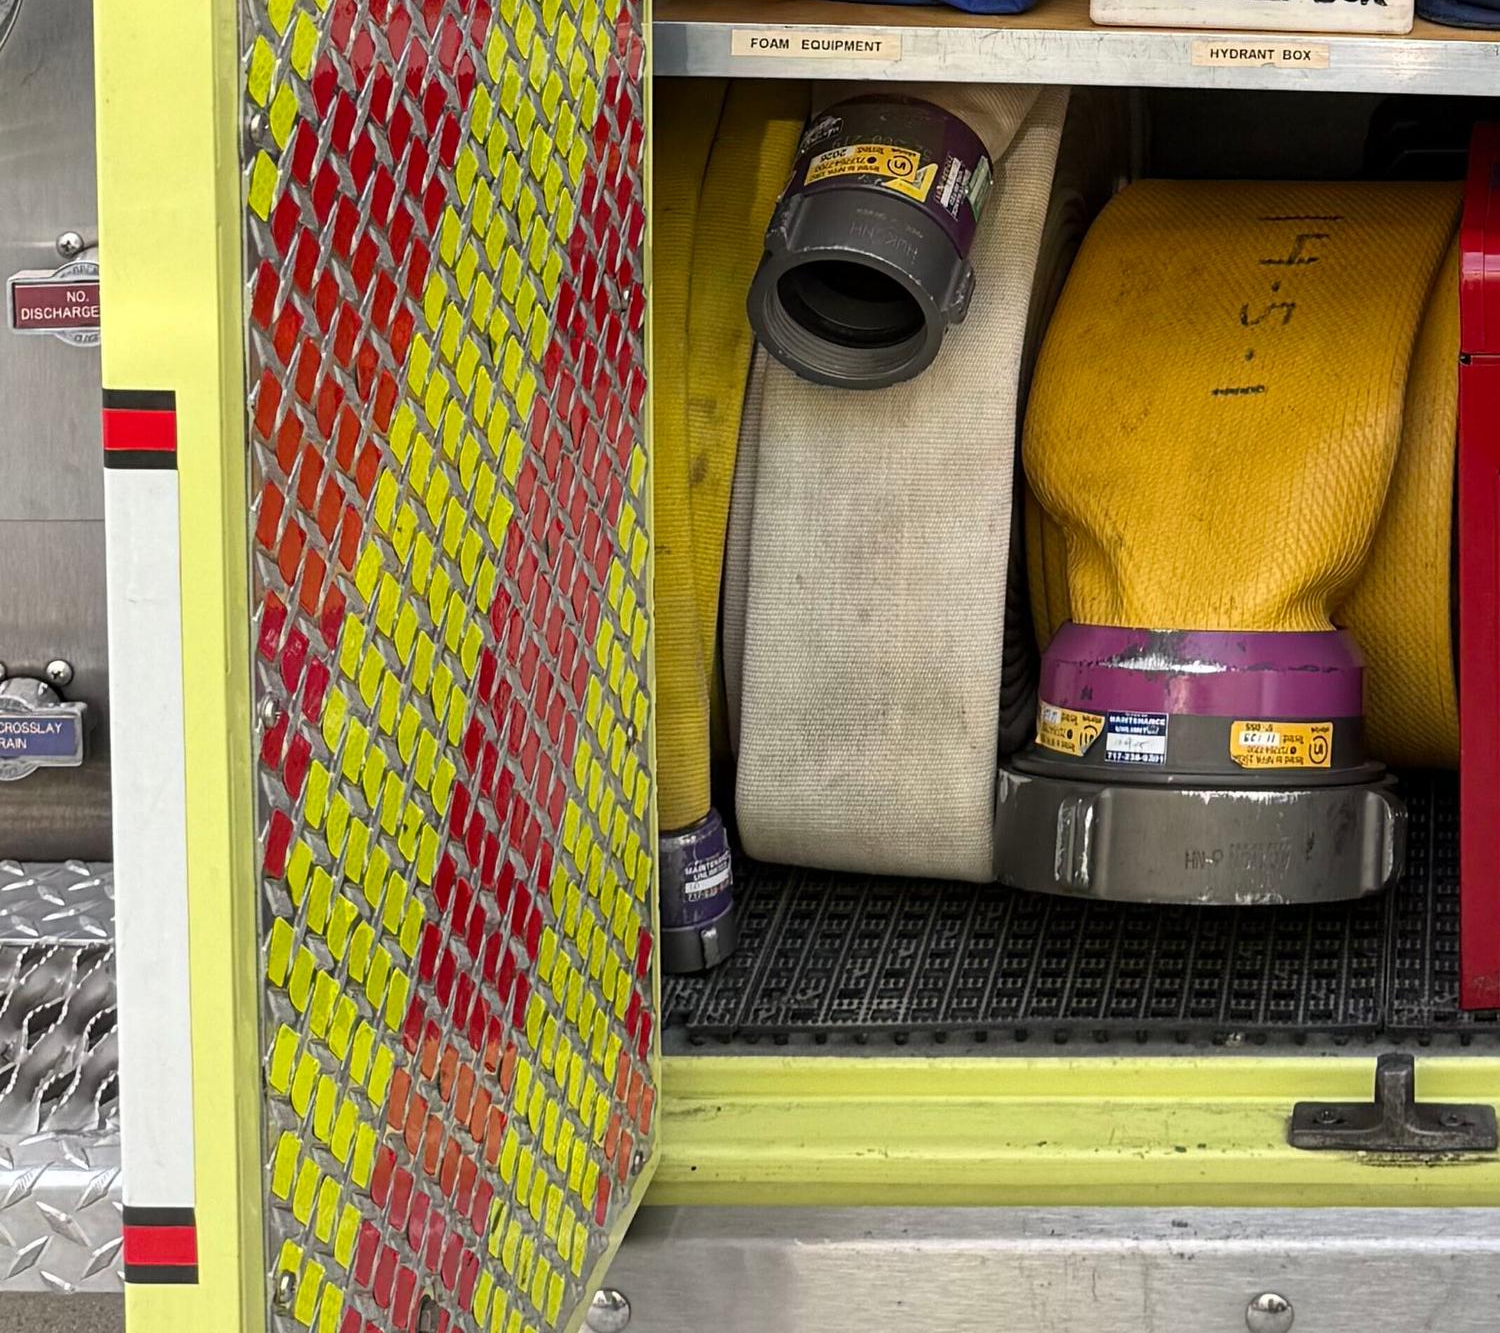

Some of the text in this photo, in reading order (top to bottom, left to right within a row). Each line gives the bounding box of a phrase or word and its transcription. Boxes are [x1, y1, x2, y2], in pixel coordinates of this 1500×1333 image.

[750, 37, 883, 52] FOAM EQUIPMENT
[1209, 48, 1312, 61] HYDRANT BOX
[66, 290, 90, 303] NO.
[21, 305, 100, 321] DISCHARGE
[0, 738, 28, 749] RAIN
